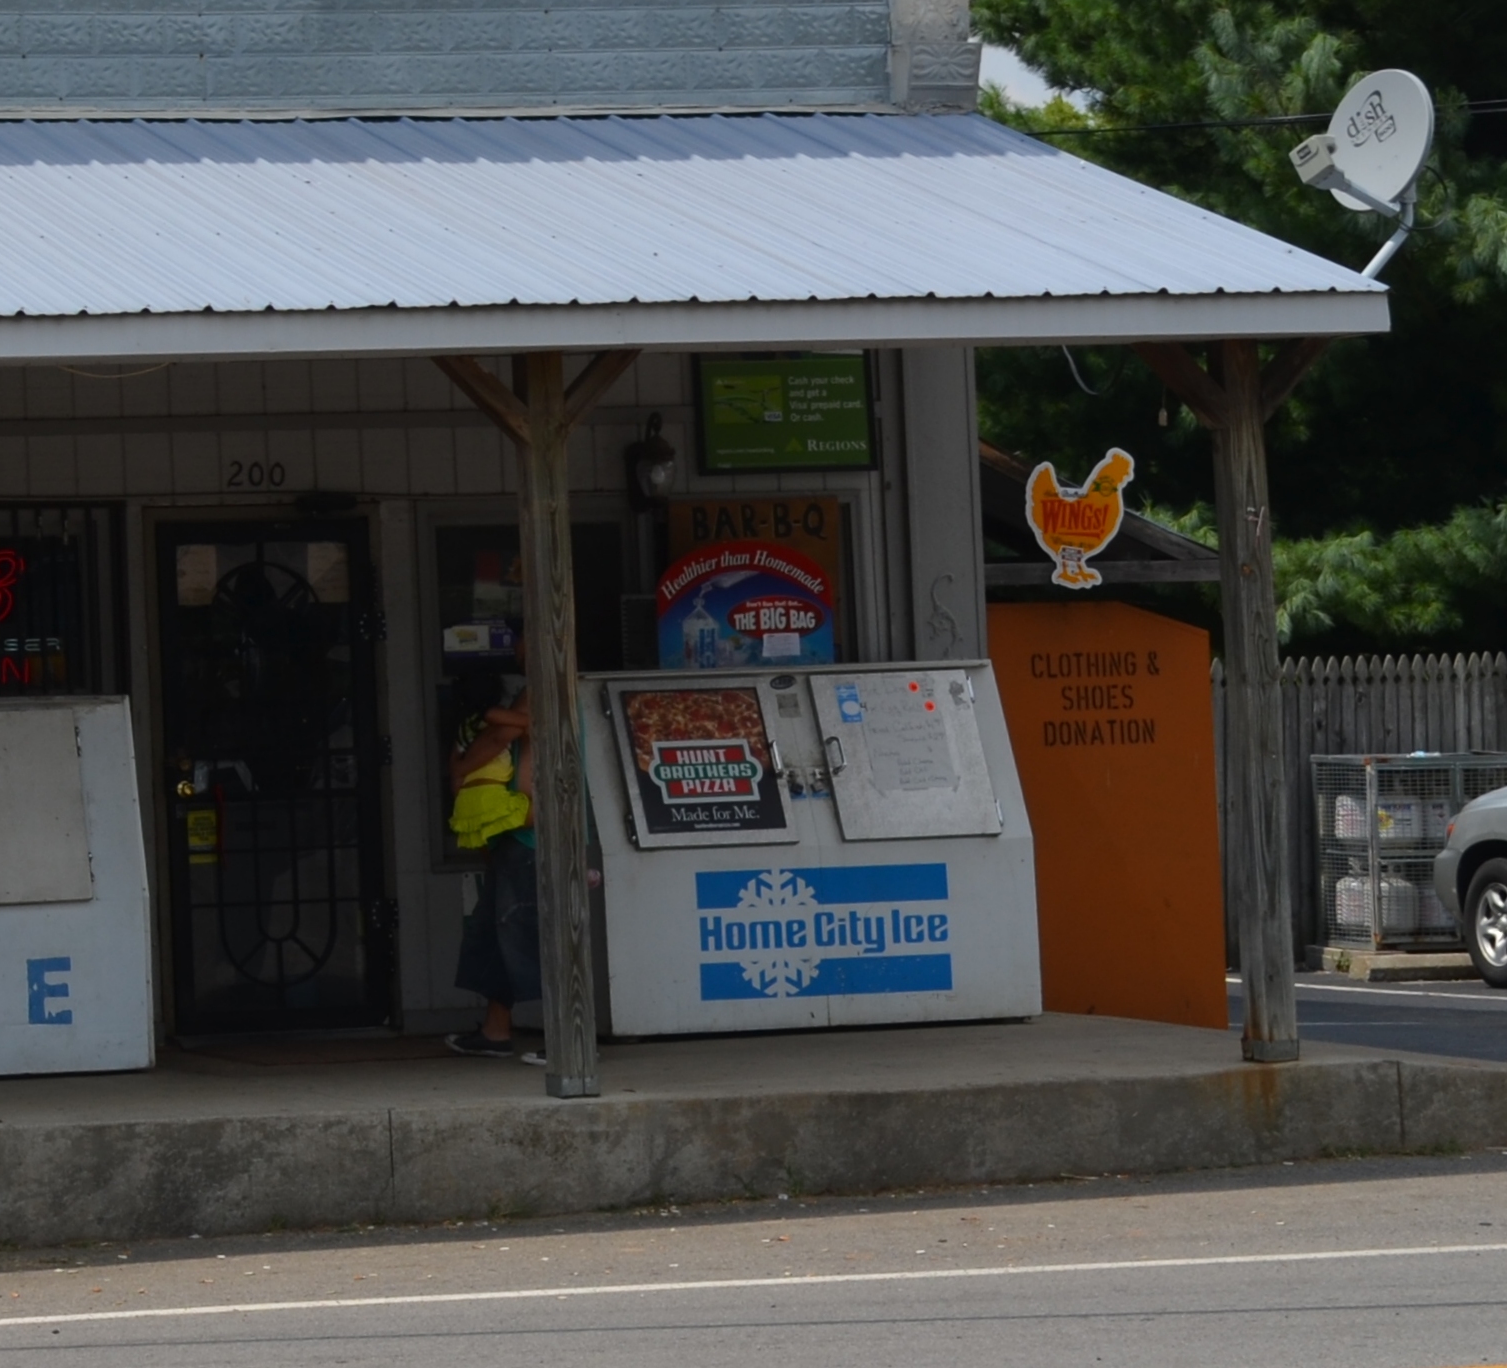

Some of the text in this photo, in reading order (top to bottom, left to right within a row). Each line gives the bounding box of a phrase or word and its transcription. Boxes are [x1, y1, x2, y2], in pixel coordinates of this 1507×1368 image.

[788, 375, 855, 387] Cash your check
[807, 438, 867, 452] REGIONS
[227, 461, 285, 488] 200
[691, 502, 828, 542] BAR-B-Q
[661, 549, 825, 601] Healthier than Homemade
[733, 608, 816, 630] THE BIG BAG
[1031, 651, 1160, 679] CLOTHING &
[1061, 684, 1134, 711] SHOES
[1043, 718, 1155, 747] DONATION
[676, 749, 727, 764] HUNT
[659, 763, 753, 780] BROTHERS
[681, 778, 737, 794] PIZZA
[671, 805, 760, 822] Made for Me.
[699, 909, 949, 954] Home City Ice
